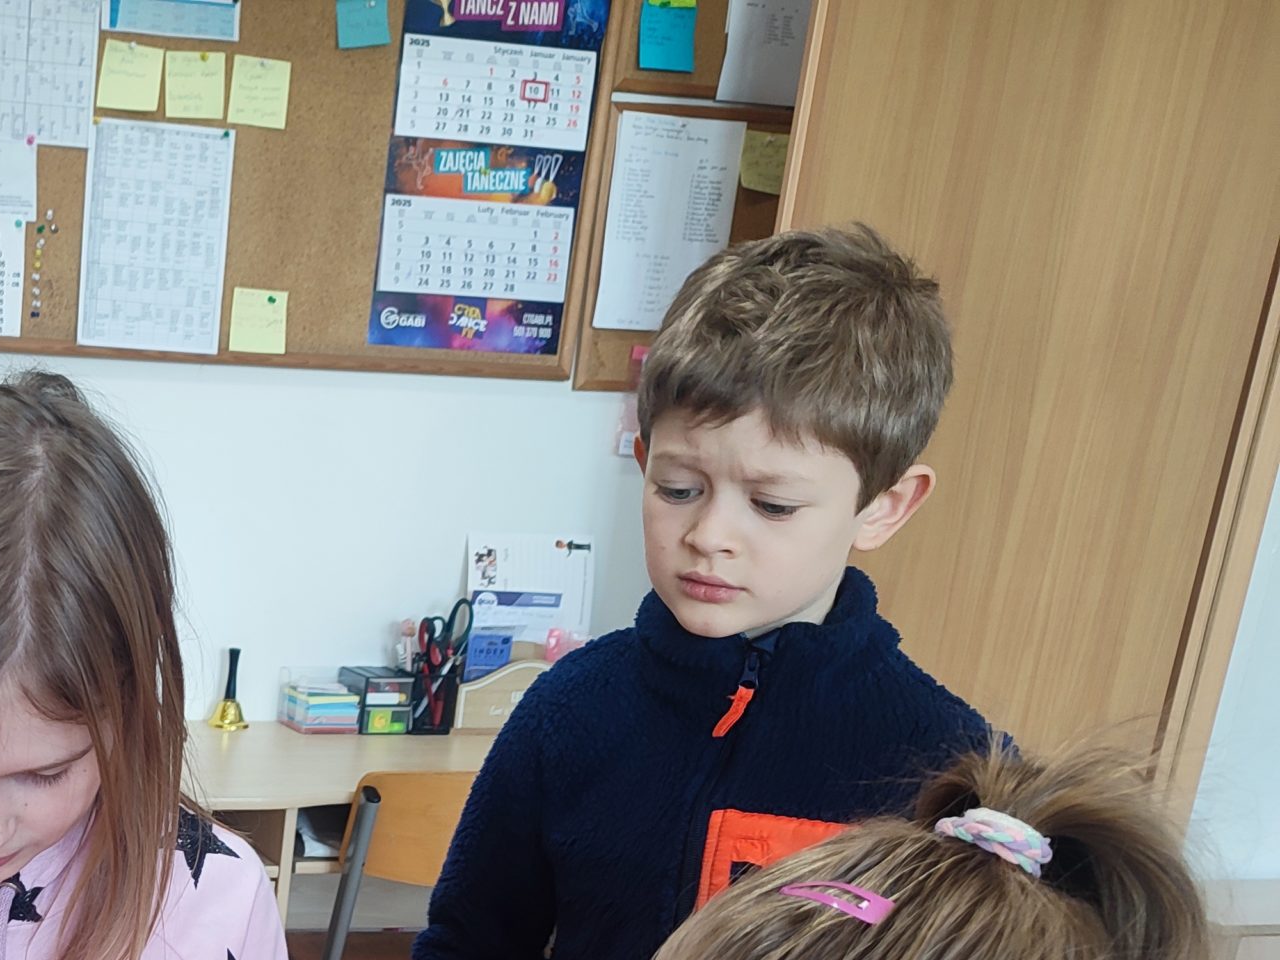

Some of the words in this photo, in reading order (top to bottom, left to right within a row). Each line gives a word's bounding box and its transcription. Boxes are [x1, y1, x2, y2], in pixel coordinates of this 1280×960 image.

[506, 2, 517, 25] Z
[519, 1, 559, 25] NAMI
[409, 38, 431, 47] 2025
[562, 53, 592, 65] January
[439, 92, 450, 102] 13
[462, 94, 472, 103] 14
[484, 96, 494, 106] 15
[505, 98, 516, 108] 16
[548, 102, 559, 111] 18
[570, 104, 580, 114] 19
[528, 86, 539, 95] 10
[550, 88, 560, 96] 11
[572, 90, 582, 99] 12
[436, 107, 448, 116] 20
[458, 108, 470, 118] 21
[481, 110, 492, 120] 22
[503, 112, 514, 122] 23
[525, 114, 535, 124] 24
[546, 116, 557, 126] 25
[567, 119, 578, 128] 26
[435, 122, 447, 130] 27
[457, 123, 469, 132] 28
[479, 125, 491, 135] 29
[501, 127, 513, 136] 30
[523, 129, 534, 138] 31
[439, 151, 485, 174] ZAJĘCIA
[467, 170, 526, 191] TANECZNE
[390, 199, 412, 208] 2025
[477, 206, 495, 217] Luty
[500, 207, 530, 217] Februar
[536, 210, 570, 221] February
[421, 250, 432, 259] 10
[442, 252, 452, 260] 11
[464, 252, 474, 262] 12
[486, 254, 496, 264] 13
[507, 256, 517, 264] 14
[528, 258, 538, 267] 15
[549, 259, 559, 268] 16
[420, 264, 430, 273] 17
[442, 266, 452, 274] 18
[463, 267, 474, 276] 19
[483, 268, 495, 278] 20
[505, 270, 516, 278] 21
[526, 271, 537, 280] 22
[546, 273, 558, 282] 23
[418, 278, 429, 286] 24
[439, 279, 451, 288] 25
[461, 280, 472, 290] 26
[482, 282, 494, 290] 27
[504, 283, 515, 292] 28
